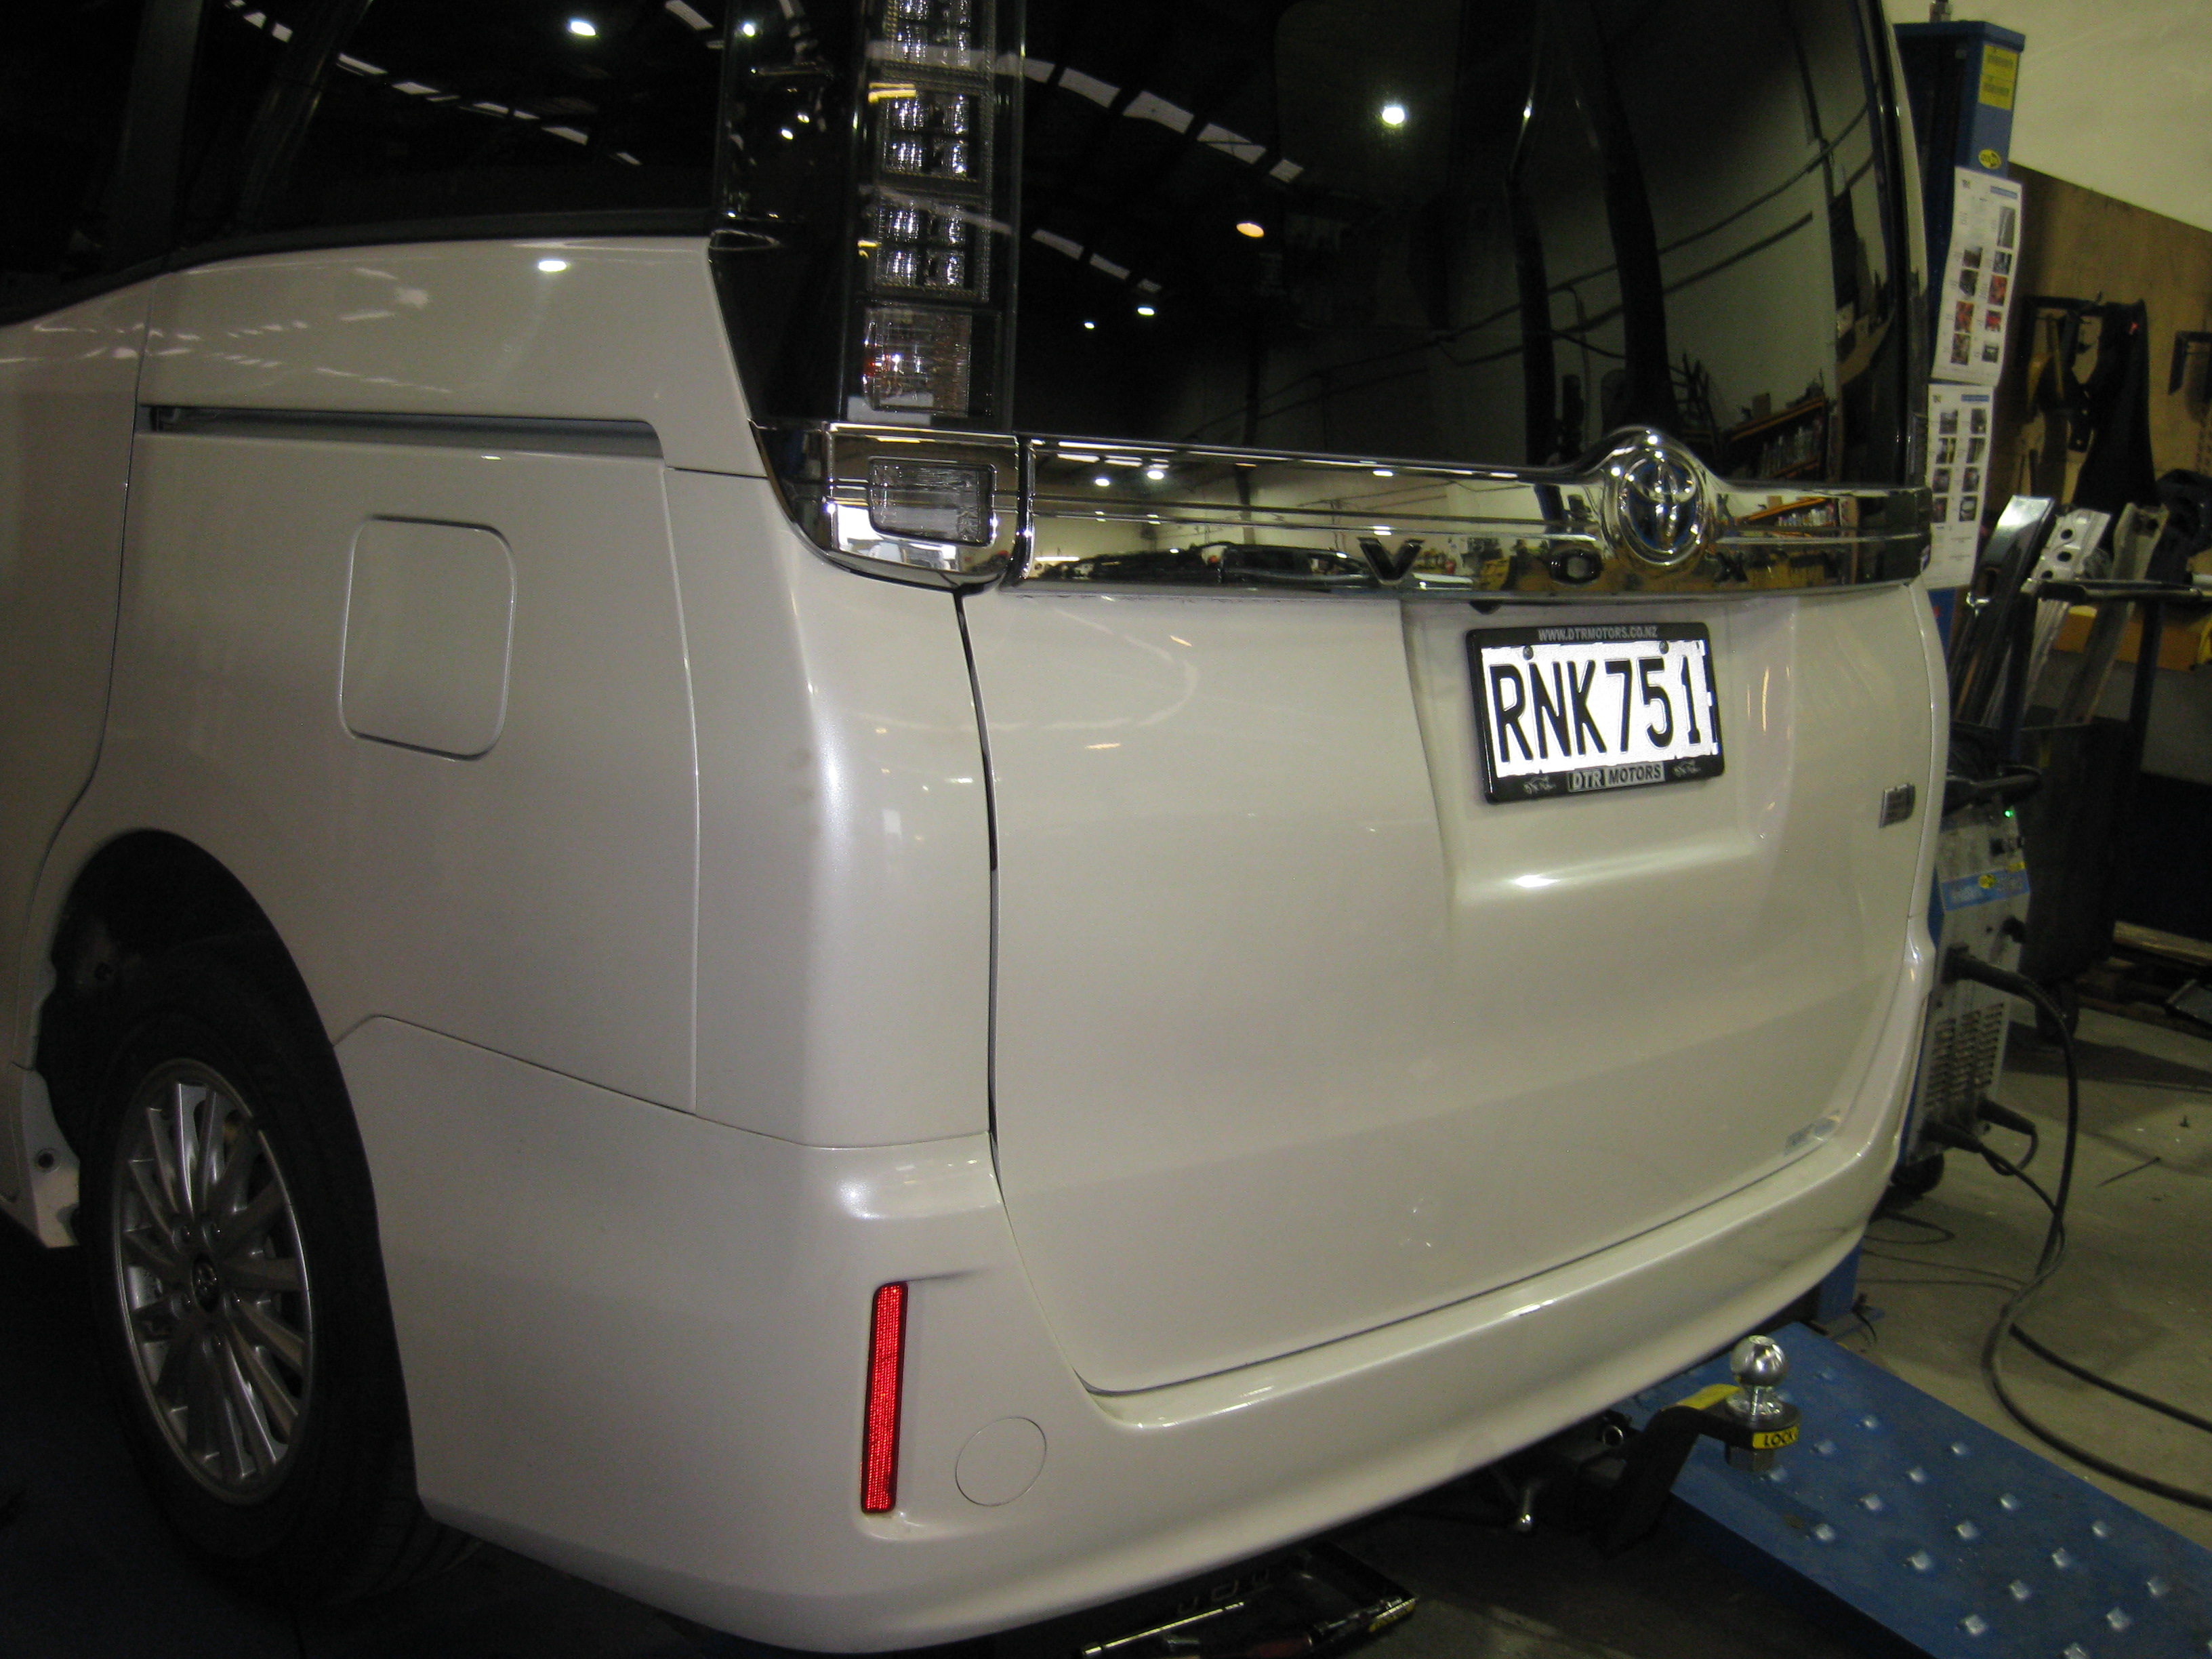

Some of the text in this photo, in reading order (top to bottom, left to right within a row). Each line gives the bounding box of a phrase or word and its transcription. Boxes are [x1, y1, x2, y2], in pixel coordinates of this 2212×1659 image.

[1538, 625, 1658, 642] WWW.DTRMOTORS.CO.NZ
[1489, 655, 1702, 763] RNK751
[1571, 769, 1603, 790] DTR
[1609, 764, 1662, 785] MOTORS
